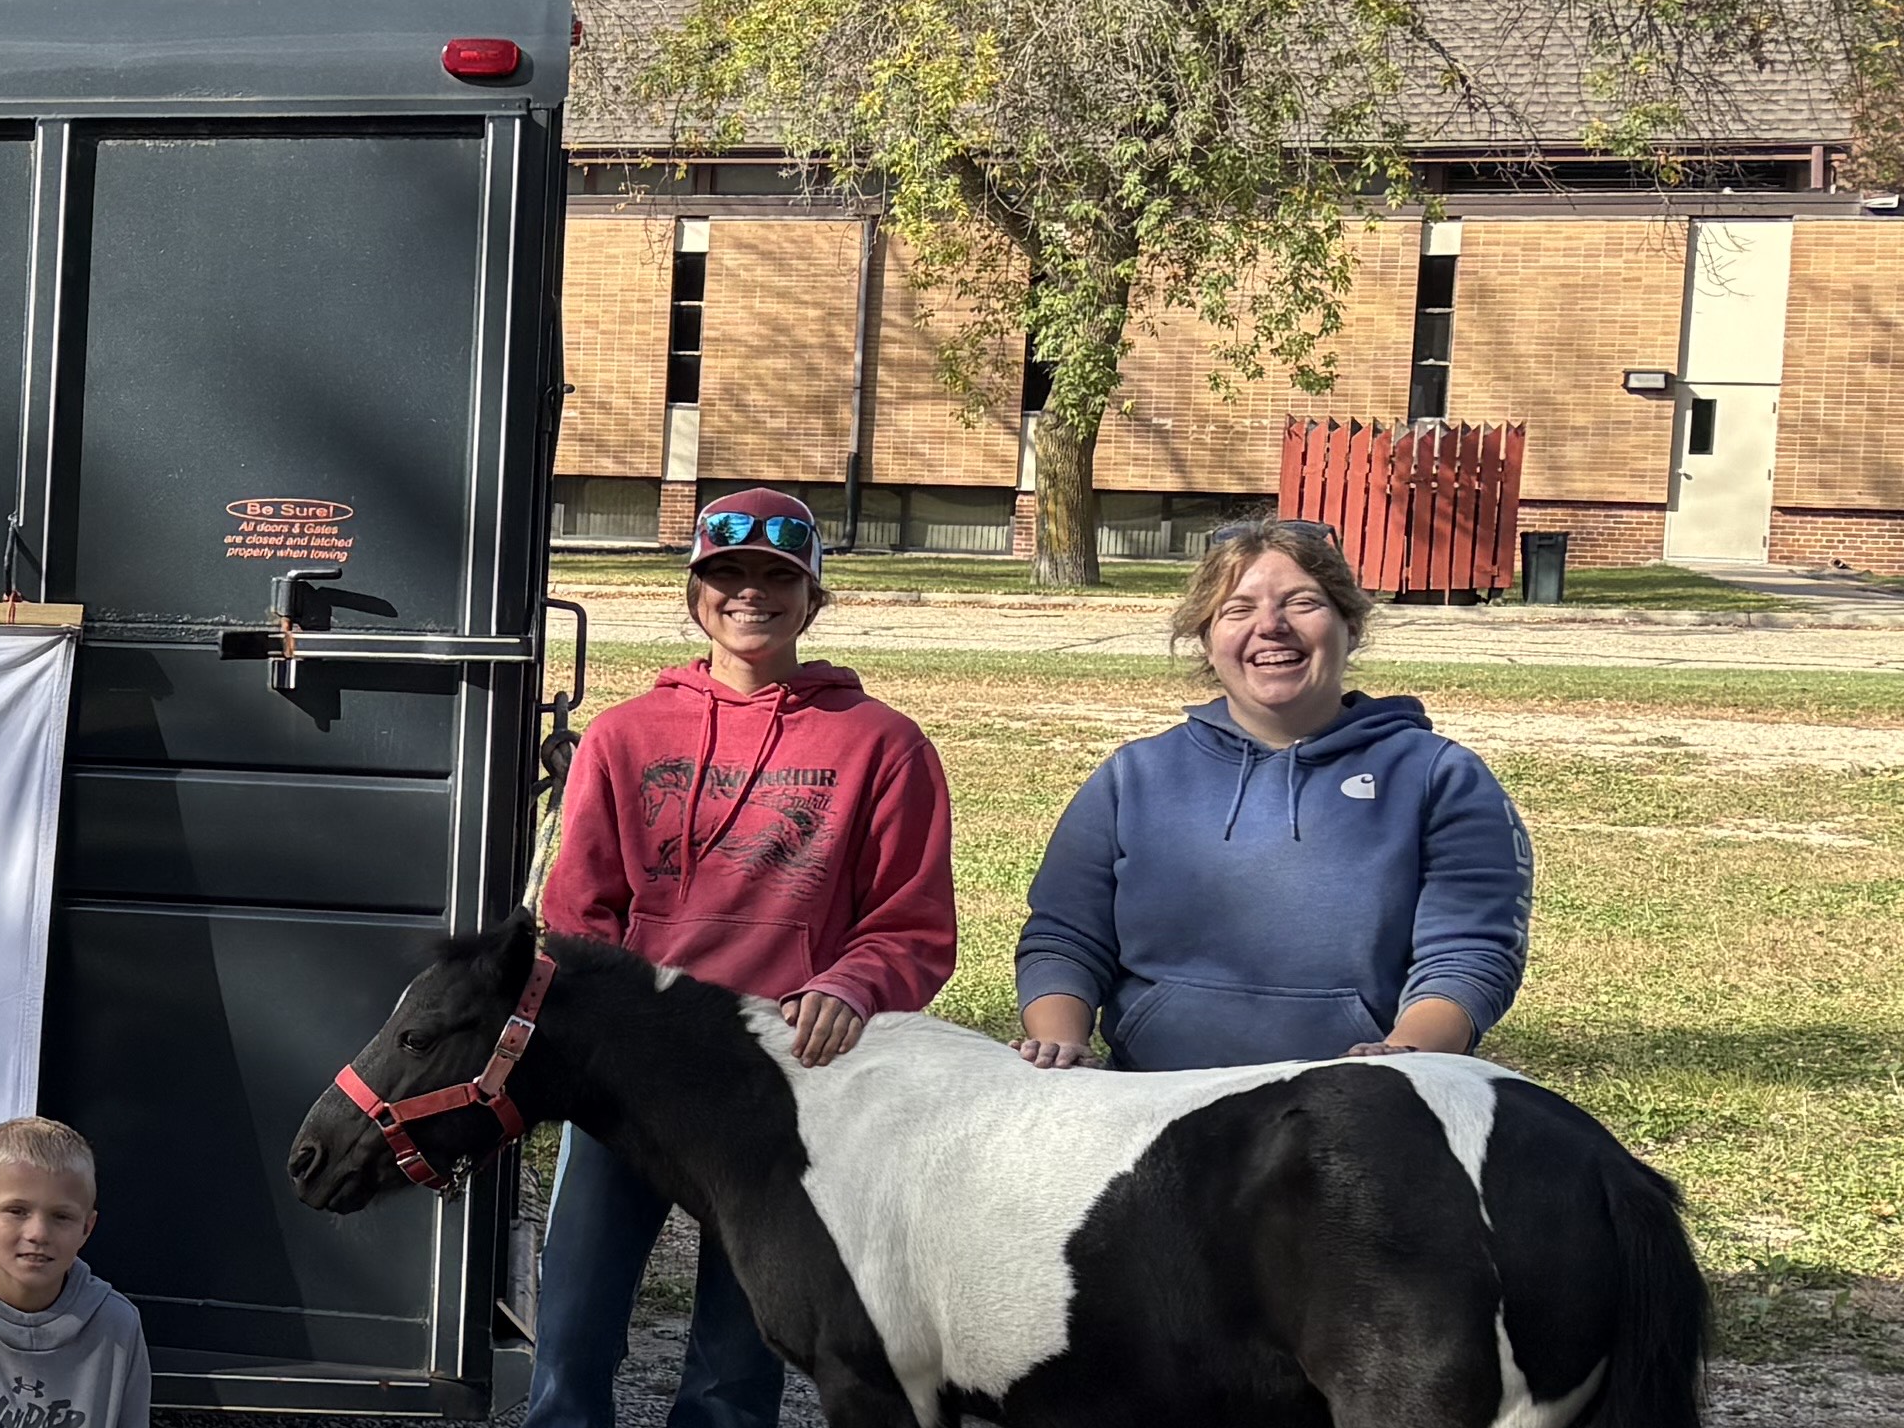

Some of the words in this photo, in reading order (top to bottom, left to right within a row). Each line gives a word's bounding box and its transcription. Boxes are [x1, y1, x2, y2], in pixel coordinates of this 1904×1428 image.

[246, 502, 274, 516] Be
[280, 503, 334, 518] Sure!
[238, 521, 254, 532] All
[256, 522, 289, 533] doors
[292, 523, 300, 534] &
[304, 523, 339, 535] Gates
[223, 534, 244, 544] are
[245, 533, 284, 545] closed
[286, 535, 309, 546] and
[310, 536, 353, 548] latched
[226, 547, 274, 560] properly
[276, 548, 307, 559] when
[310, 549, 349, 562] towing
